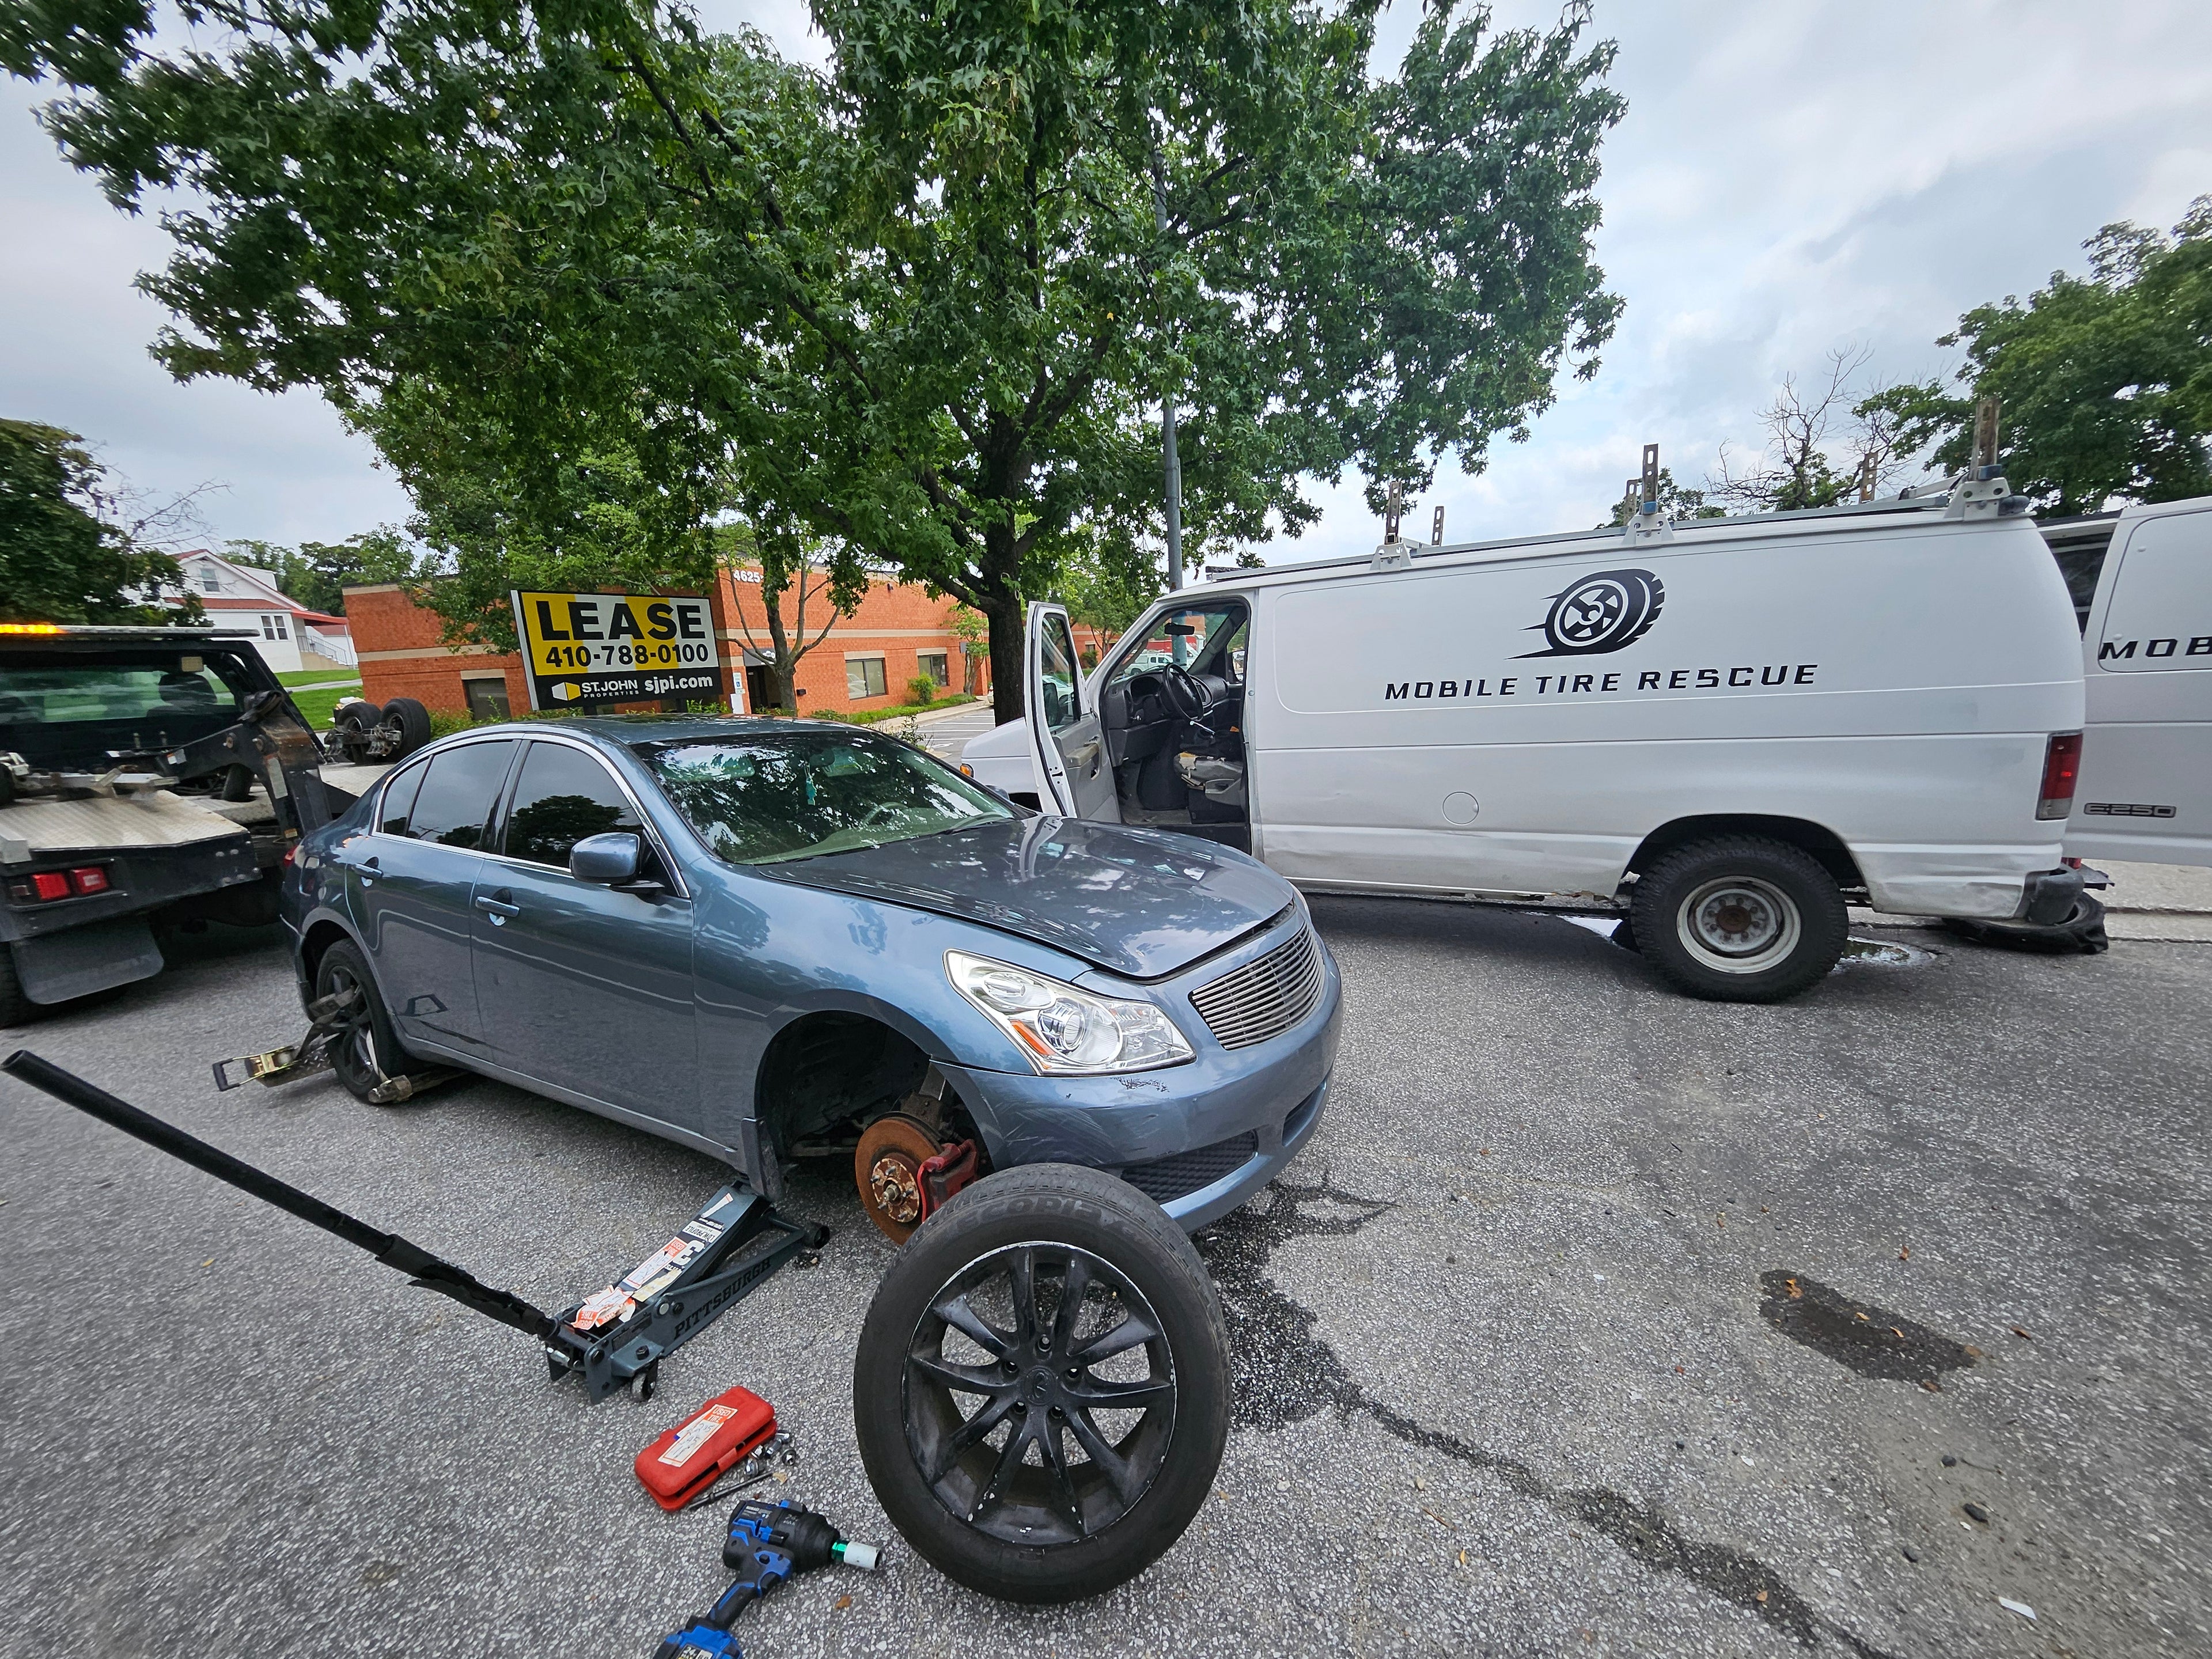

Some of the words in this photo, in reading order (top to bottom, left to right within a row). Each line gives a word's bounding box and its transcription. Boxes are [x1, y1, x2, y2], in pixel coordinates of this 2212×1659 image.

[536, 600, 706, 641] LEASE
[546, 643, 709, 668] 410-788-0100
[584, 690, 639, 699] PROPERTIES
[644, 675, 713, 694] sjpi.com
[1385, 677, 1518, 700] MOBILE
[1535, 672, 1622, 694] TIRE
[1637, 664, 1819, 691] RESCUE
[672, 1240, 705, 1266] 3
[673, 1257, 771, 1341] PITTSBURGH
[707, 1414, 721, 1423] TIRE
[713, 1407, 732, 1416] USED
